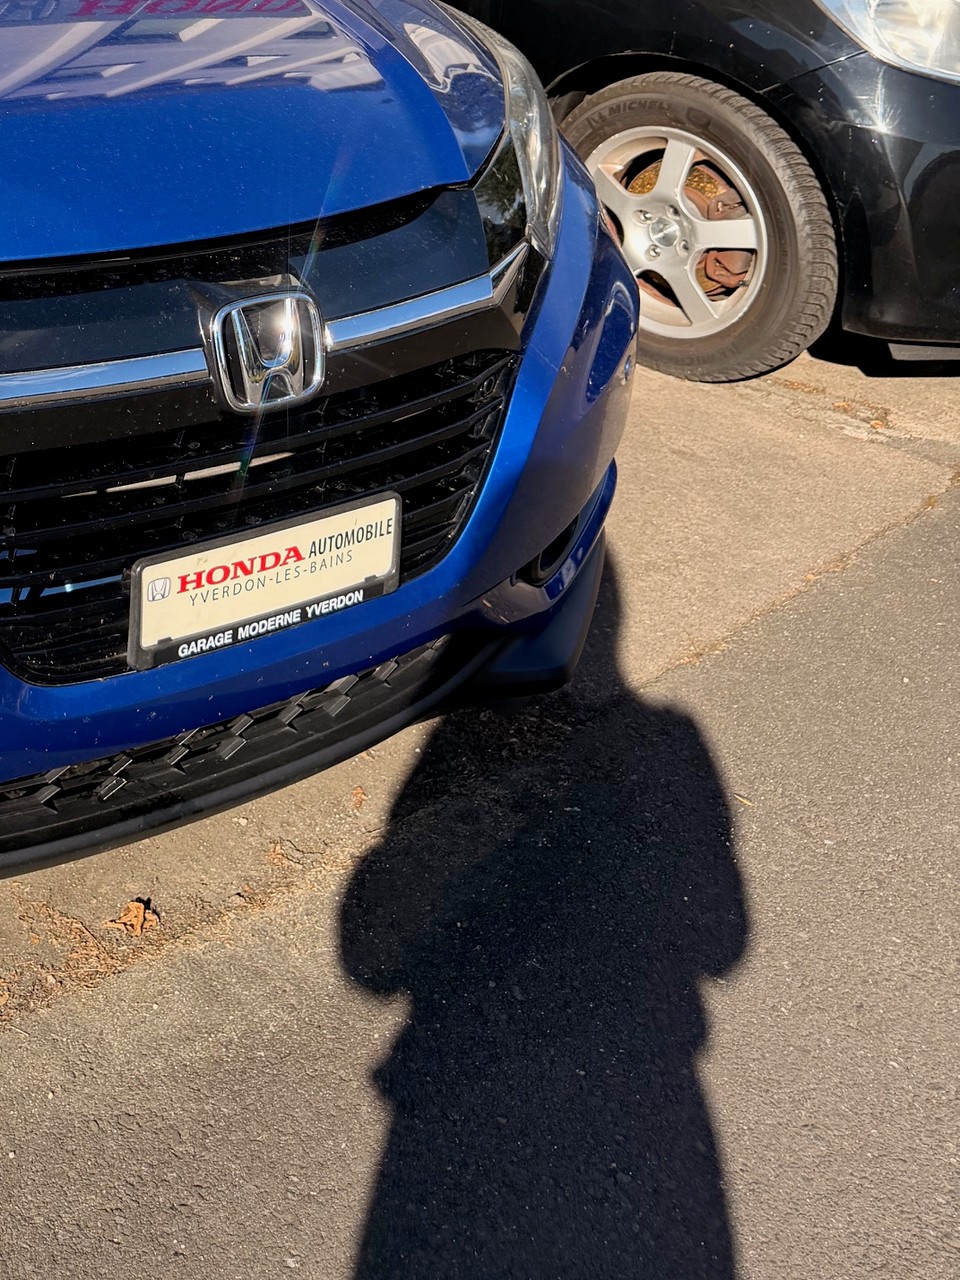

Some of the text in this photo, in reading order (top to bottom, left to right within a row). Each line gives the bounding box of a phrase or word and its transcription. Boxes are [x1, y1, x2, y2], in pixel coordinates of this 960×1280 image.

[176, 545, 306, 595] HONDA
[308, 517, 393, 559] AUTOMOBILE
[190, 549, 354, 606] YVERDON-LES-BAINS
[178, 589, 364, 658] GARAGE MODERNE YVERDON
